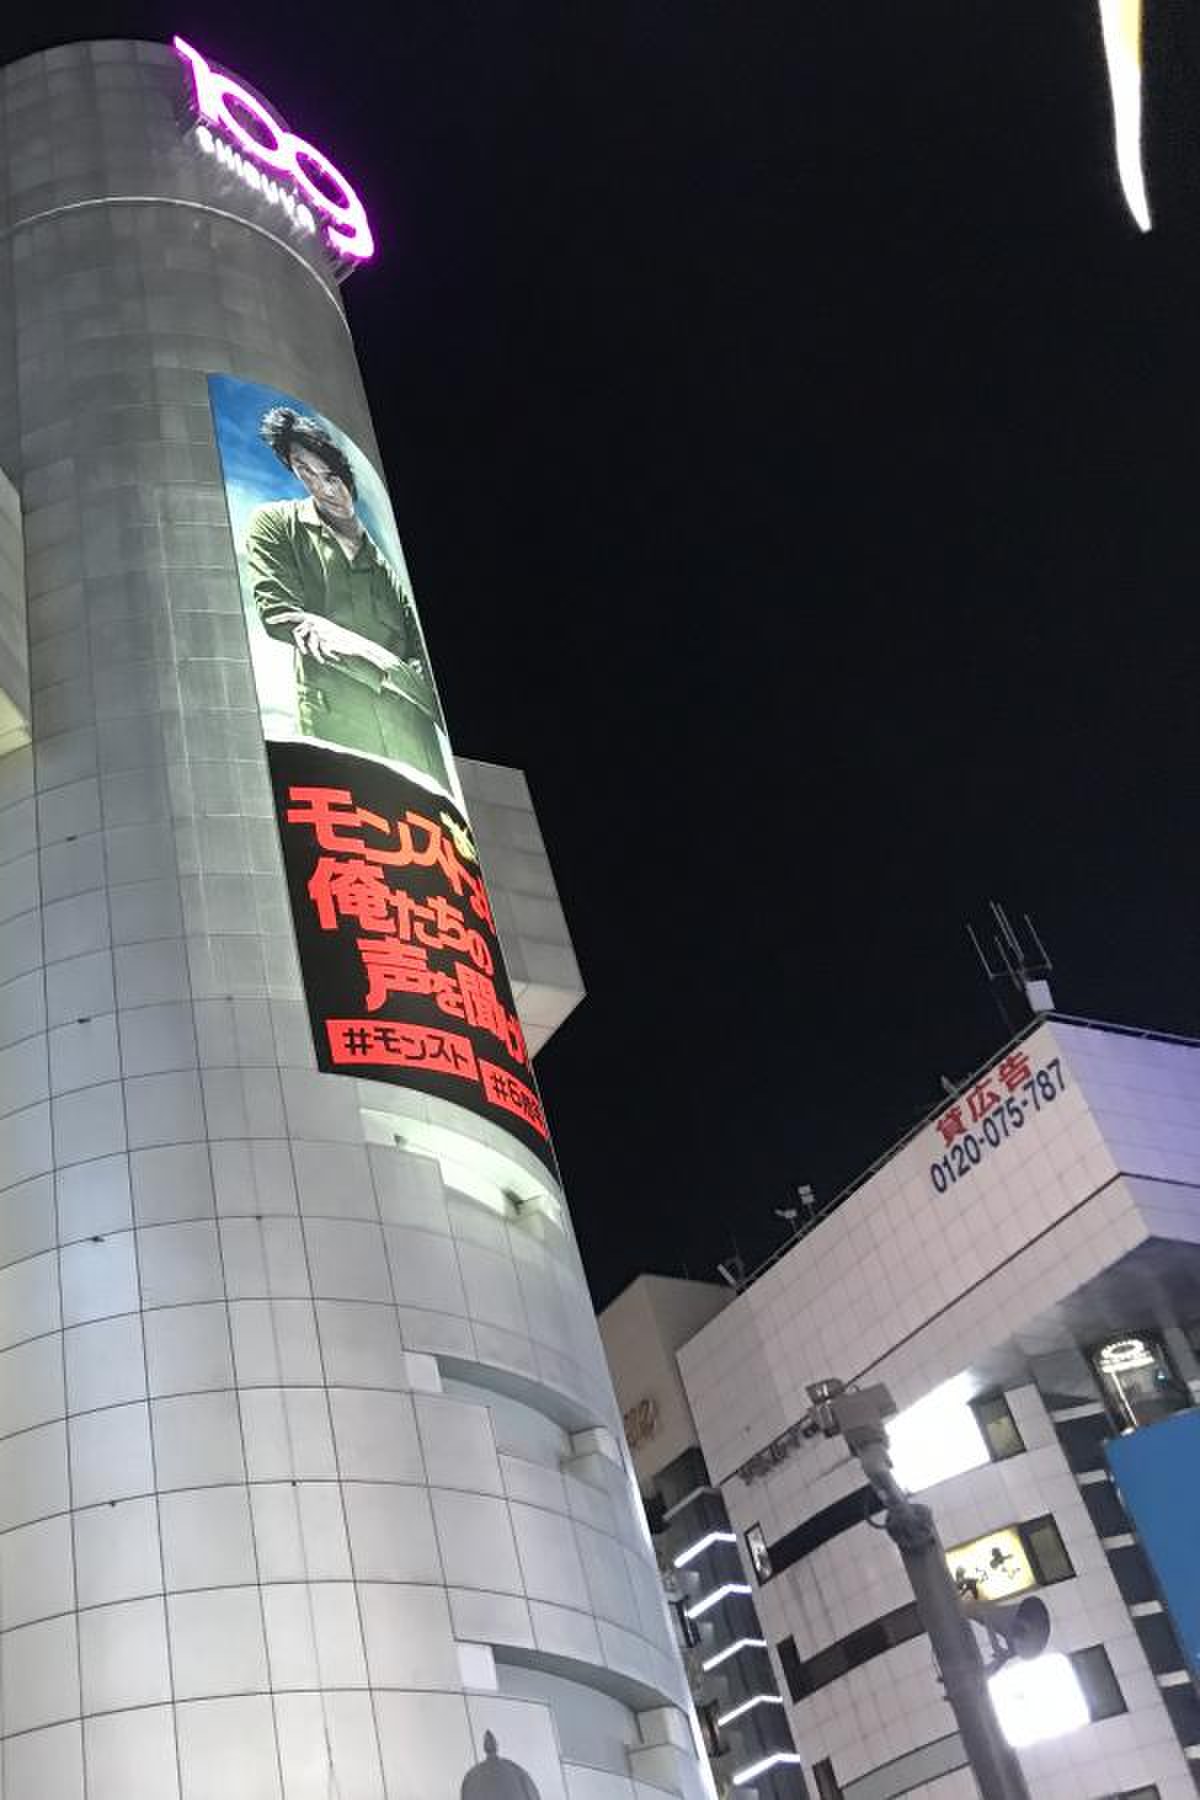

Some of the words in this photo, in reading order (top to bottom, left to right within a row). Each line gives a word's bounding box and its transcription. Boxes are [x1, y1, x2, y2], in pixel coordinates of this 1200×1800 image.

[173, 34, 374, 258] 109
[306, 856, 495, 977] 俺たちの
[342, 1026, 469, 1070] #モンスト
[930, 1057, 1065, 1194] 0120-075-787
